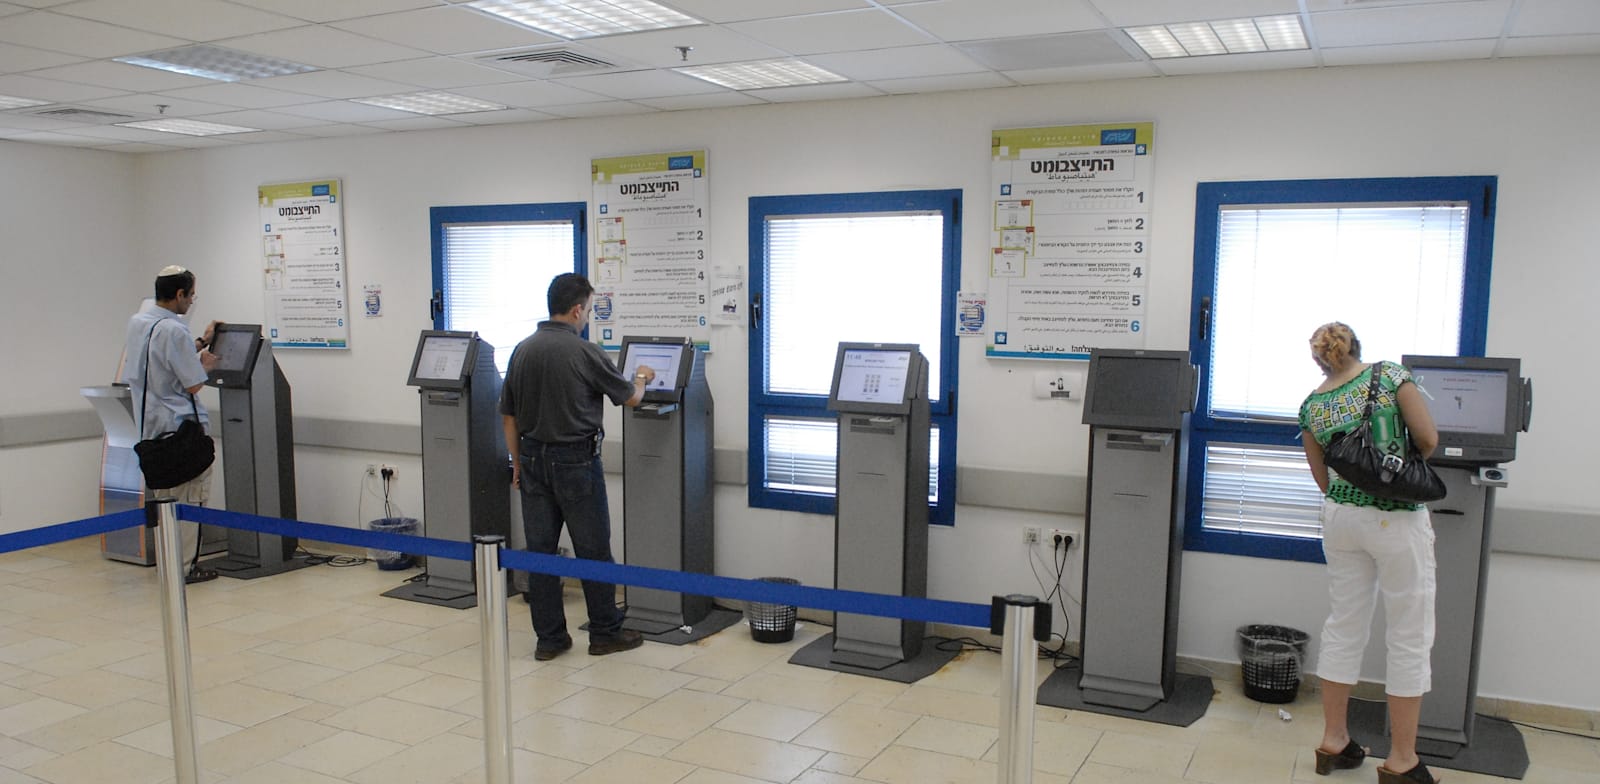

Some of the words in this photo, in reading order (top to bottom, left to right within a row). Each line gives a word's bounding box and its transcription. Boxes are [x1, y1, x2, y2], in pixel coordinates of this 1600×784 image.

[1031, 158, 1114, 173] התייצבומט
[620, 181, 679, 195] התייצבומט
[1137, 192, 1144, 203] 1
[279, 205, 320, 216] התייצבומט
[697, 208, 702, 218] 1
[1136, 218, 1144, 230] 2
[333, 228, 337, 236] 1
[697, 230, 704, 240] 2
[334, 246, 339, 255] 2
[1134, 242, 1143, 253] 3
[697, 250, 704, 260] 3
[335, 263, 340, 271] 3
[698, 272, 704, 280] 4
[1133, 267, 1142, 278] 4
[337, 300, 342, 309] 5
[698, 295, 705, 304] 5
[1132, 295, 1140, 306] 5
[338, 319, 343, 327] 6
[699, 316, 706, 326] 6
[1131, 321, 1139, 332] 6
[1072, 343, 1098, 352] צלחה!
